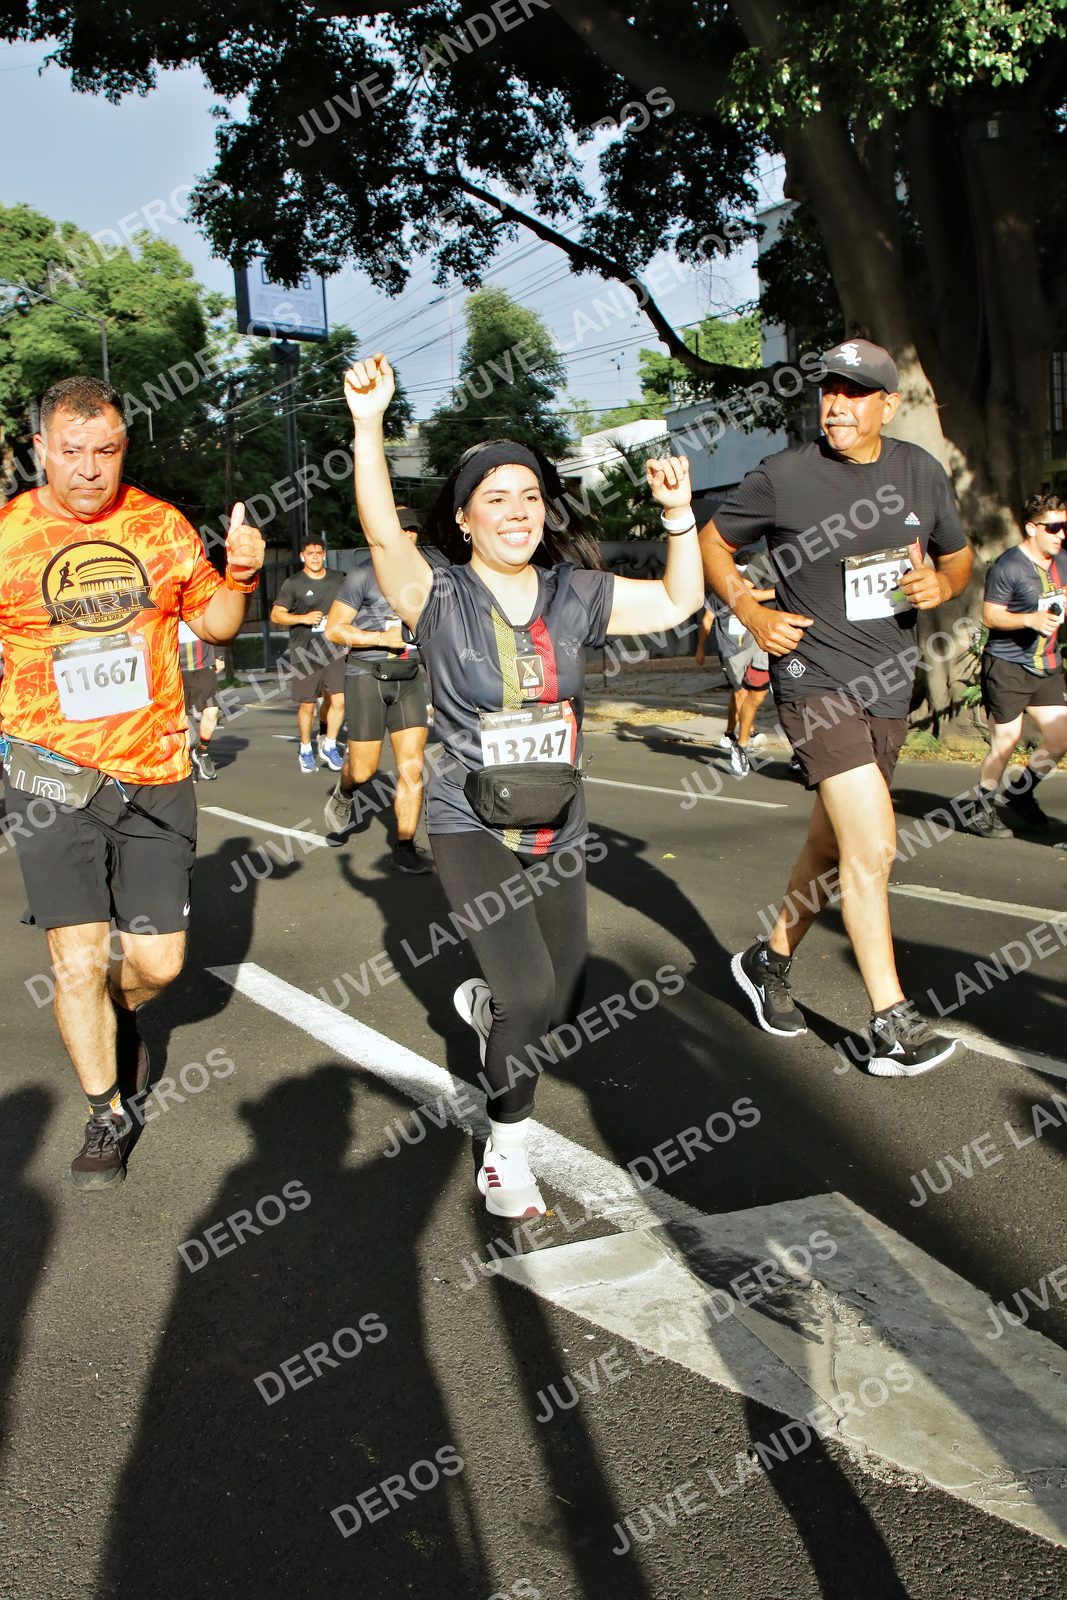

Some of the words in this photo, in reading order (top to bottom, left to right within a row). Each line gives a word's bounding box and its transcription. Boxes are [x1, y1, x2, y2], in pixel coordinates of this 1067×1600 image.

[851, 569, 903, 598] 1153
[53, 586, 146, 621] MRT
[60, 656, 138, 694] 11667
[487, 728, 567, 764] 13247
